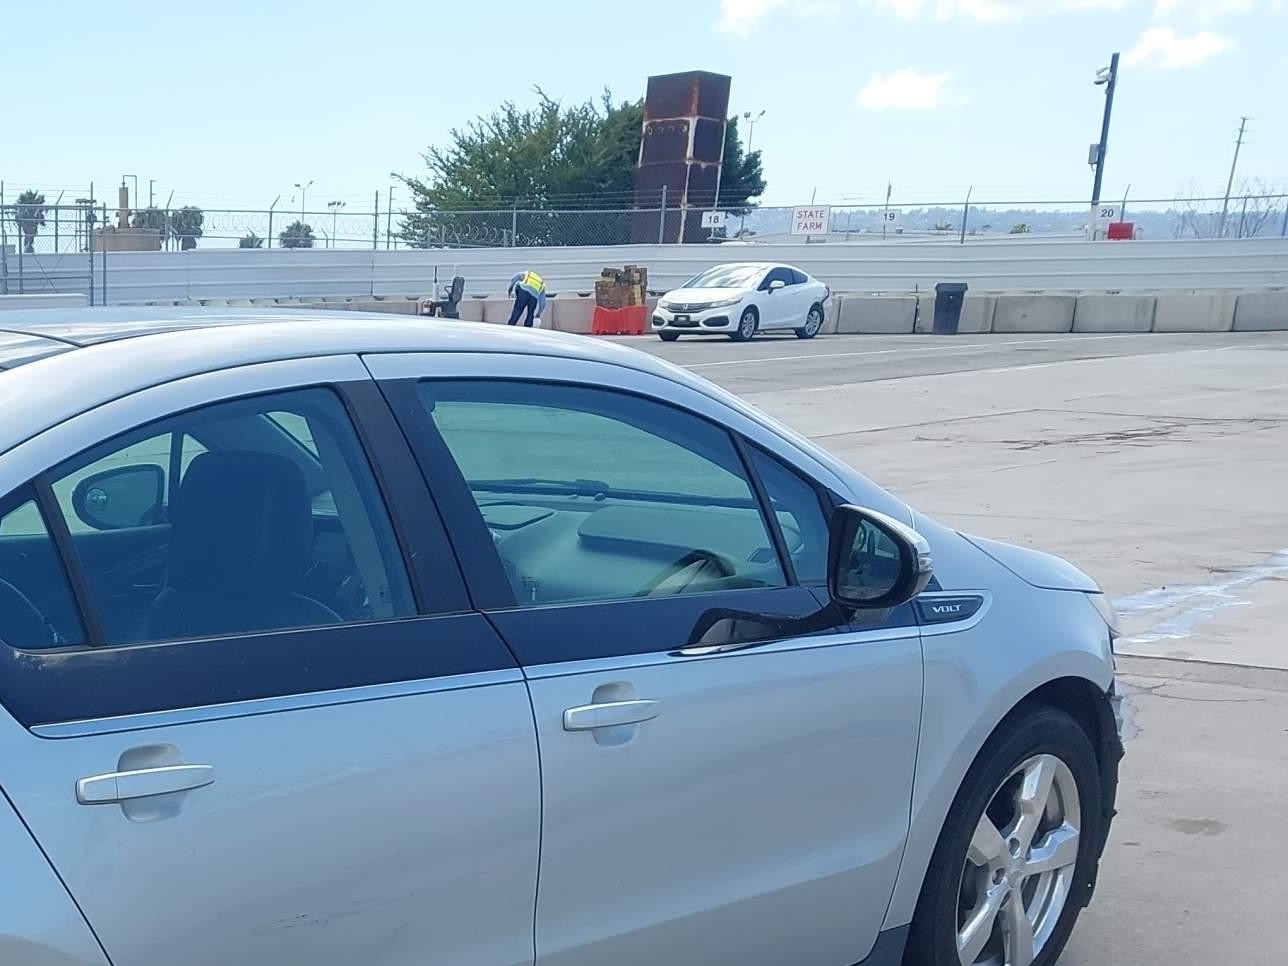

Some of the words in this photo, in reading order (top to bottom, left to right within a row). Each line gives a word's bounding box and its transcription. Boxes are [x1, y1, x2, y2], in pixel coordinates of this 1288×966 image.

[797, 209, 825, 219] STATE
[883, 212, 895, 222] 19
[1100, 208, 1114, 218] 20
[708, 215, 720, 225] 18
[796, 222, 823, 231] FARM
[931, 604, 962, 613] VOLT
